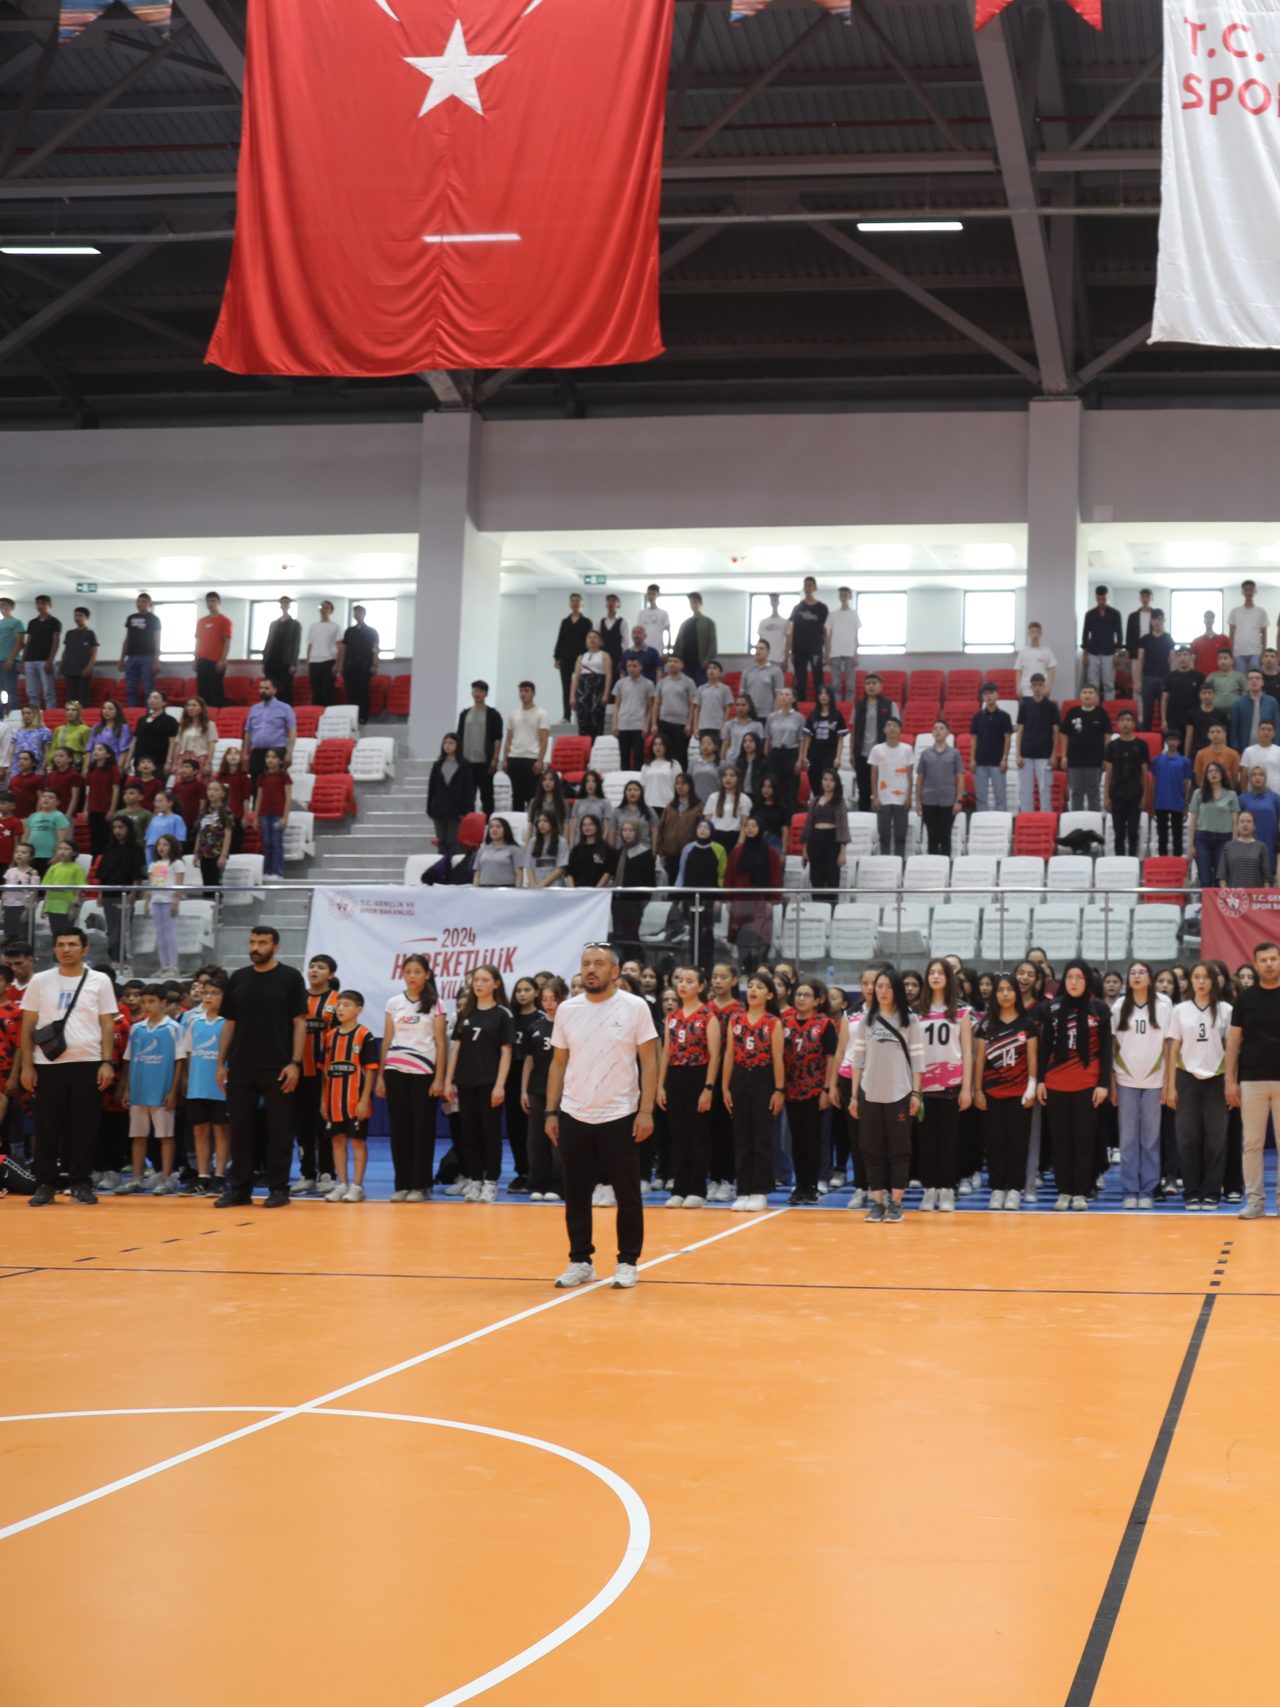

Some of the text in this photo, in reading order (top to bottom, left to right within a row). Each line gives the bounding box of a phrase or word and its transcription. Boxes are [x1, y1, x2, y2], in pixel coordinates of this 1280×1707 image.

[1183, 17, 1265, 62] T.C.
[441, 927, 476, 947] 2024
[472, 1027, 481, 1041] 7
[925, 1023, 950, 1045] 10
[1135, 1019, 1146, 1034] 10
[1199, 1023, 1206, 1038] 3
[1002, 1047, 1018, 1067] 14
